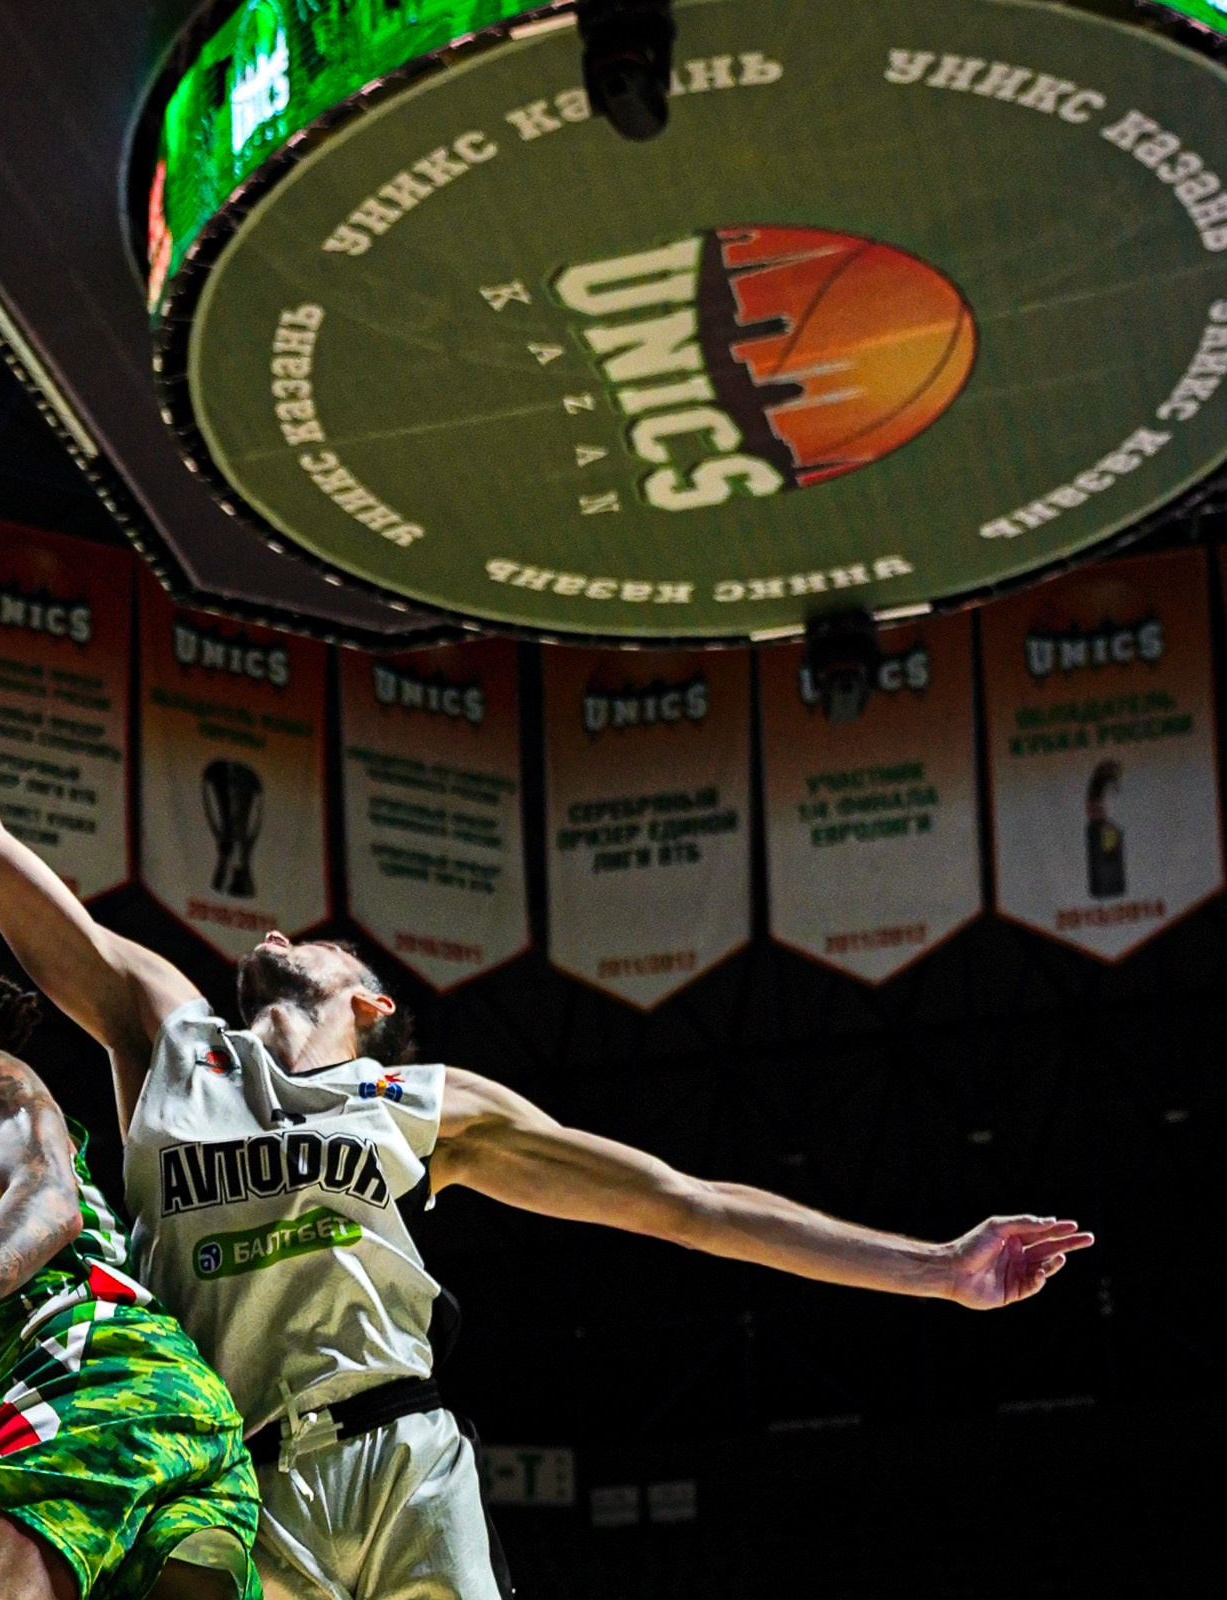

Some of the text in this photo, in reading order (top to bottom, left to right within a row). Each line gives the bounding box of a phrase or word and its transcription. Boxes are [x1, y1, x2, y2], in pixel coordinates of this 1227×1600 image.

[555, 236, 783, 511] UNICS
[175, 622, 290, 688] UNICS
[1025, 618, 1166, 678] UNICS
[374, 666, 485, 725] UNICS
[584, 681, 708, 733] UNICS
